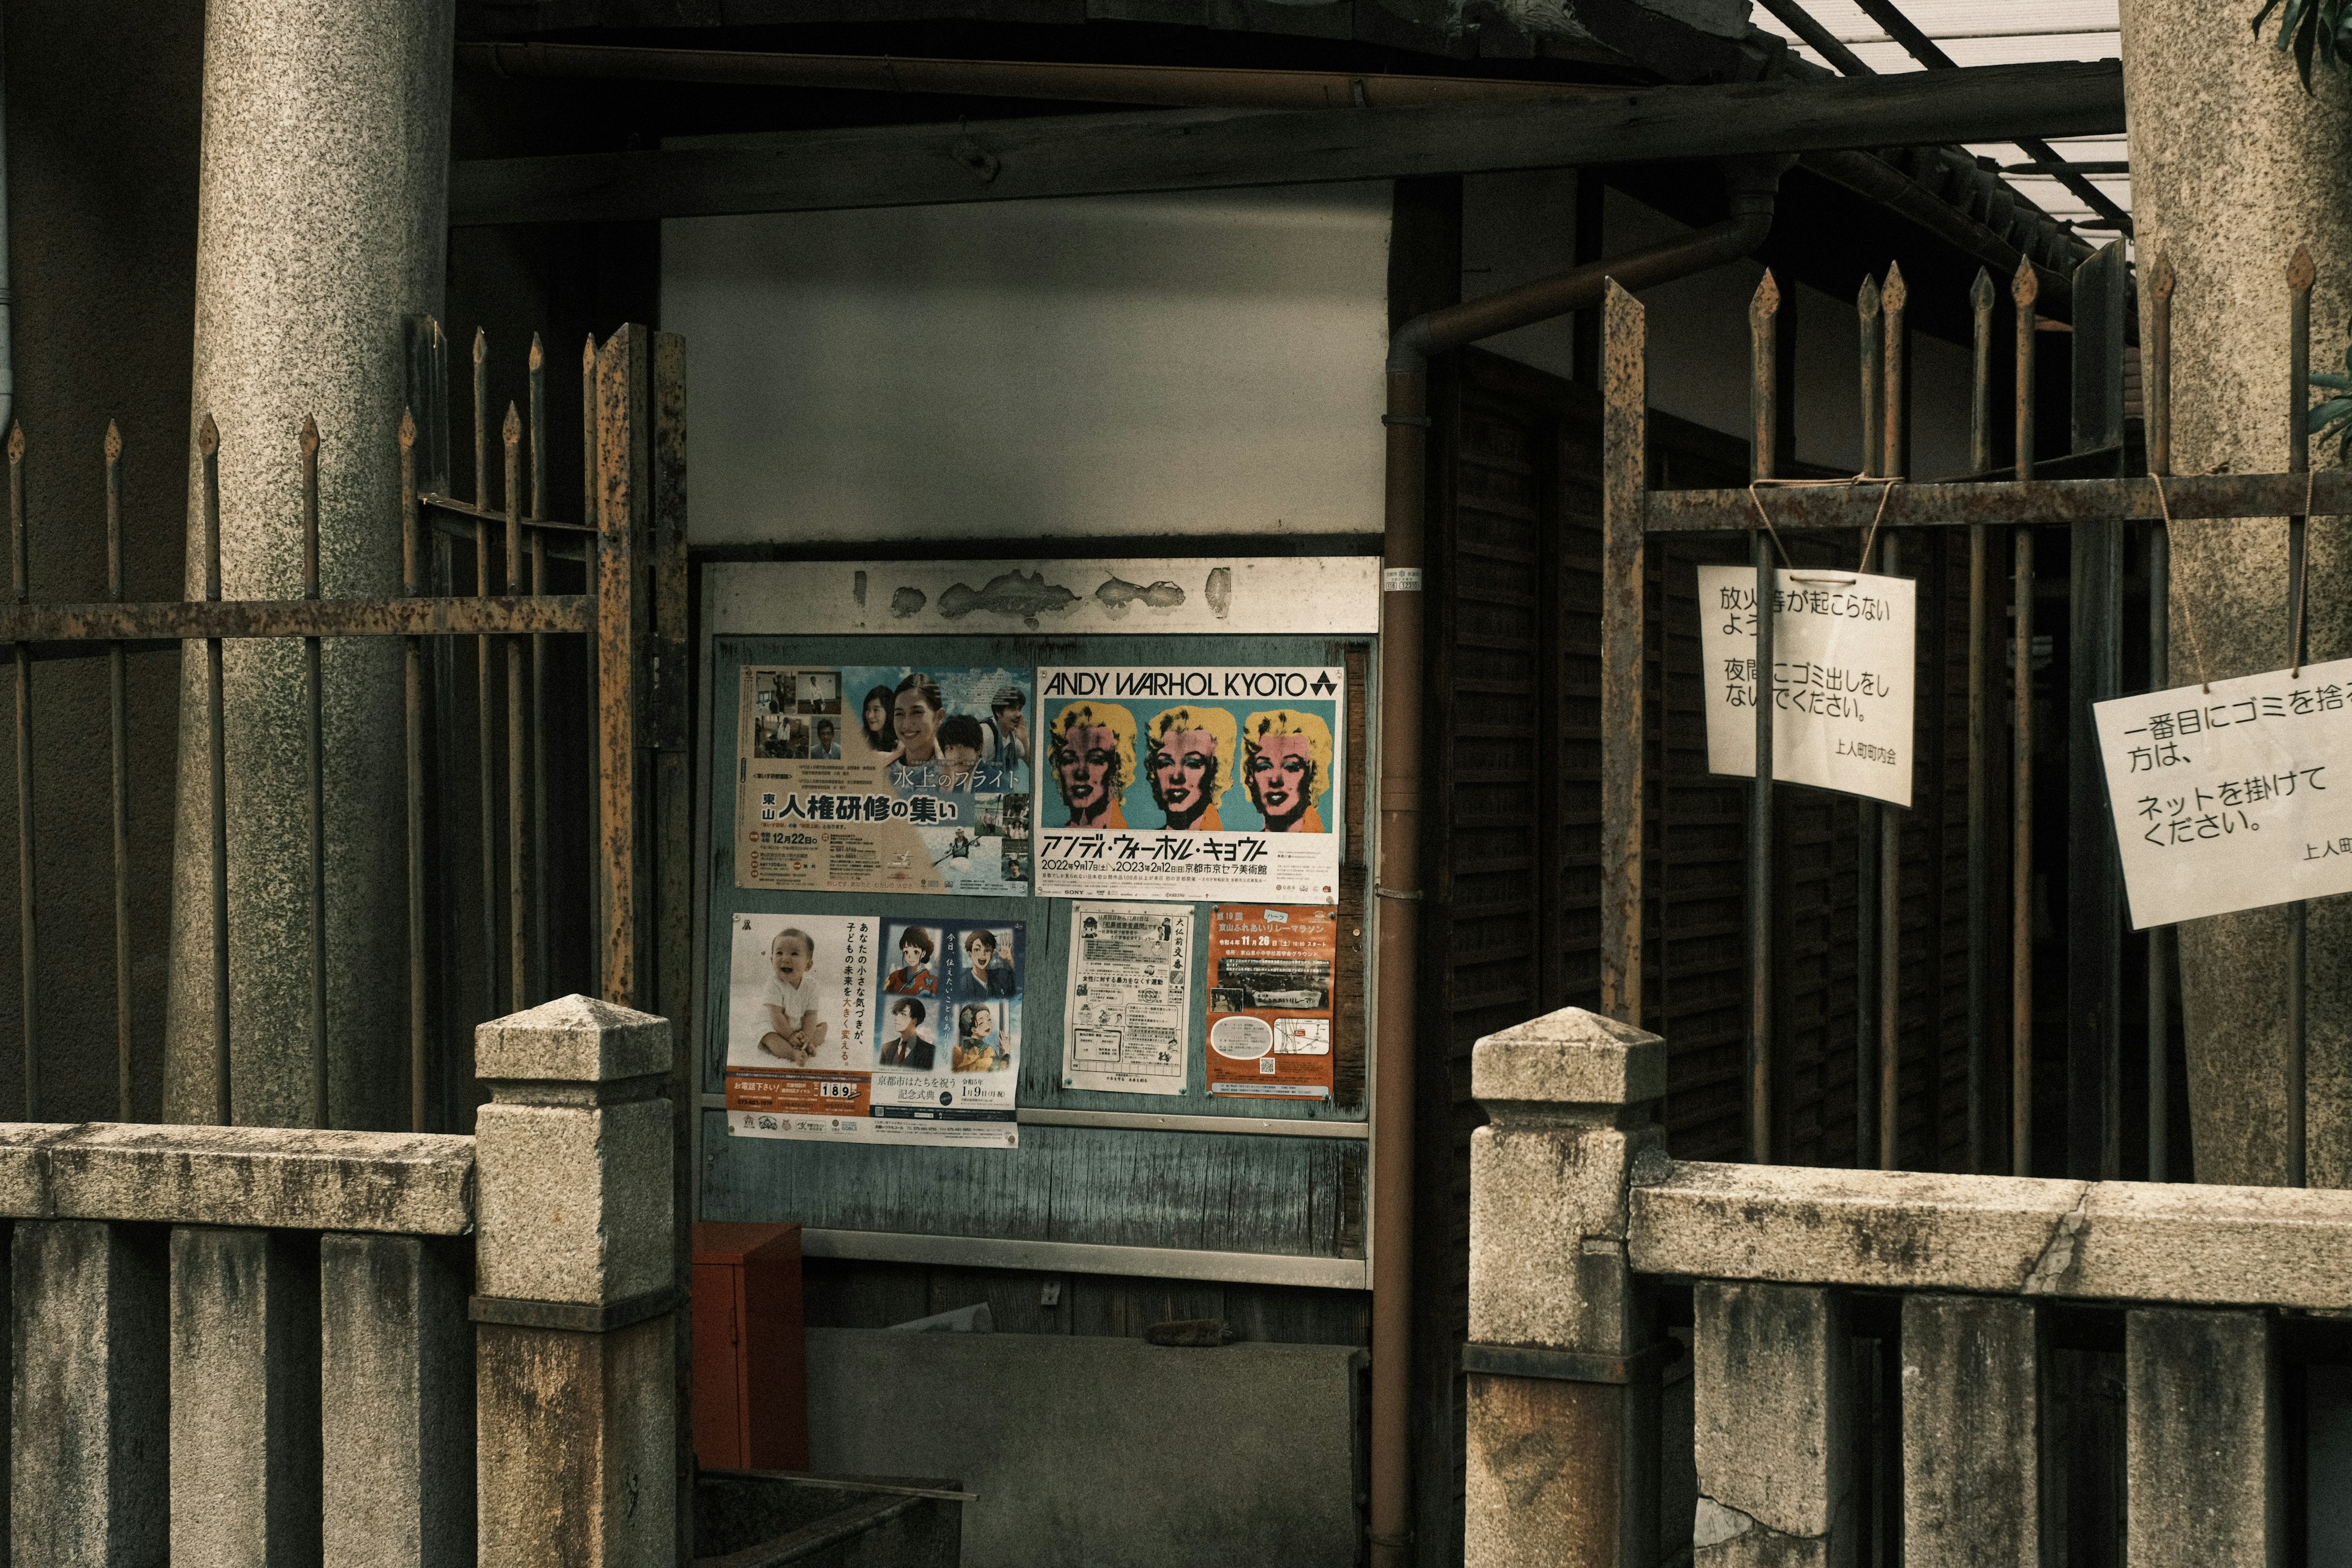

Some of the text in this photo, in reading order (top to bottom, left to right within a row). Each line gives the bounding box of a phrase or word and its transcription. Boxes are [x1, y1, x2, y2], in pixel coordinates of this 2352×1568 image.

[1043, 672, 1109, 695] ANDY
[1116, 673, 1219, 696] WARHOL
[1225, 673, 1308, 696] KYOTO
[2124, 682, 2352, 741] 一番目にゴミを捨
[1835, 738, 1896, 766] 上人町町内会
[2127, 741, 2191, 773] 方は、
[894, 766, 1019, 789] 水上のフライト
[762, 793, 776, 820] 東山
[2138, 766, 2326, 821] ネットを掛けて
[779, 795, 958, 823] 人権研修の集い
[2144, 810, 2260, 846] ください。
[1041, 833, 1268, 862] アンディ・ウォーホル・キョウト
[1185, 863, 1267, 875] 京都市京セラ美術館
[1219, 923, 1324, 933] 東山ふれあいリレーマラソン
[1172, 918, 1184, 970] 大仏前交番
[841, 922, 856, 1066] 子どもの未来を大きく変える。
[854, 923, 869, 1045] あなたの小さな気づきが、
[1082, 976, 1163, 986] 女性に対する暴力をなくす運動
[823, 1085, 850, 1096] 189
[877, 1076, 956, 1088] 京都市はたちを祝う
[898, 1090, 935, 1100] 記念式典
